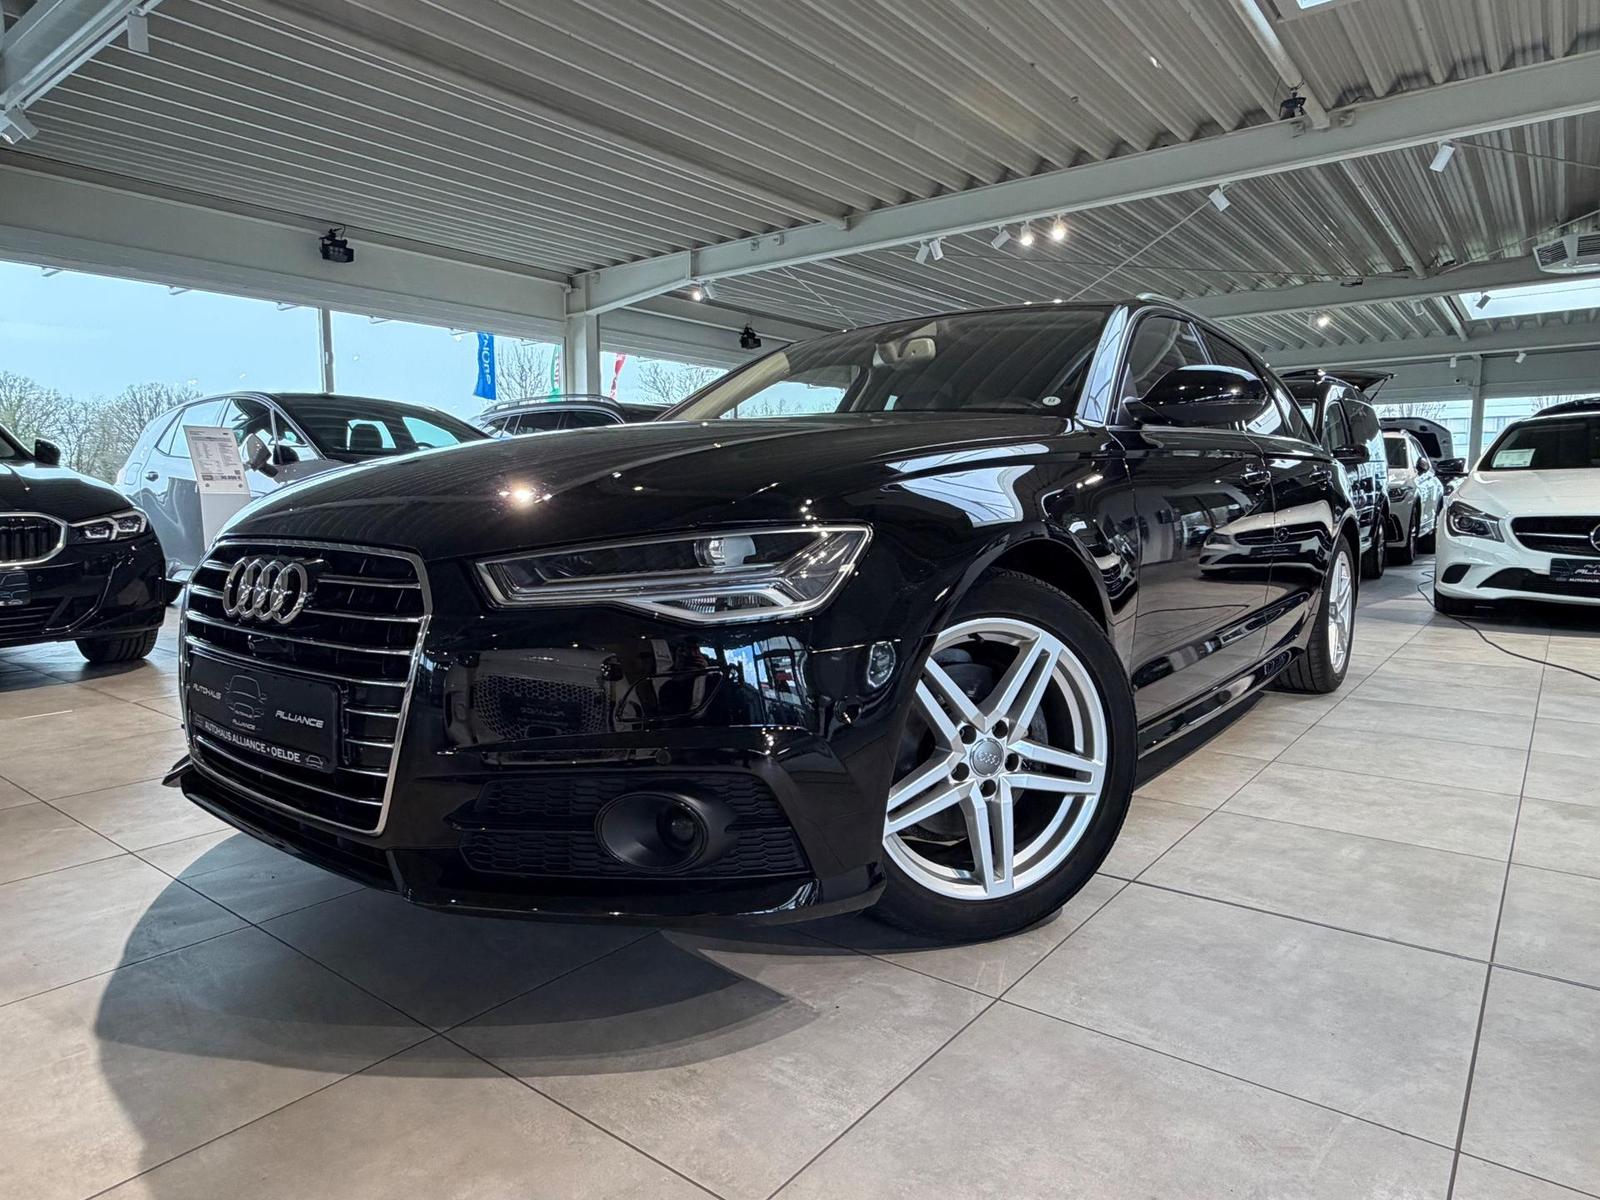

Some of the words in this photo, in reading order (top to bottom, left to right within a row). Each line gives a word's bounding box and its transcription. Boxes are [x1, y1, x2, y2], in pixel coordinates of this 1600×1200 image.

[193, 683, 221, 700] AUTOHAUS
[275, 710, 325, 728] ALLIANCE
[205, 721, 232, 741] AUTOHAUS
[232, 734, 266, 753] ALLIANCE
[271, 746, 301, 763] OELDE
